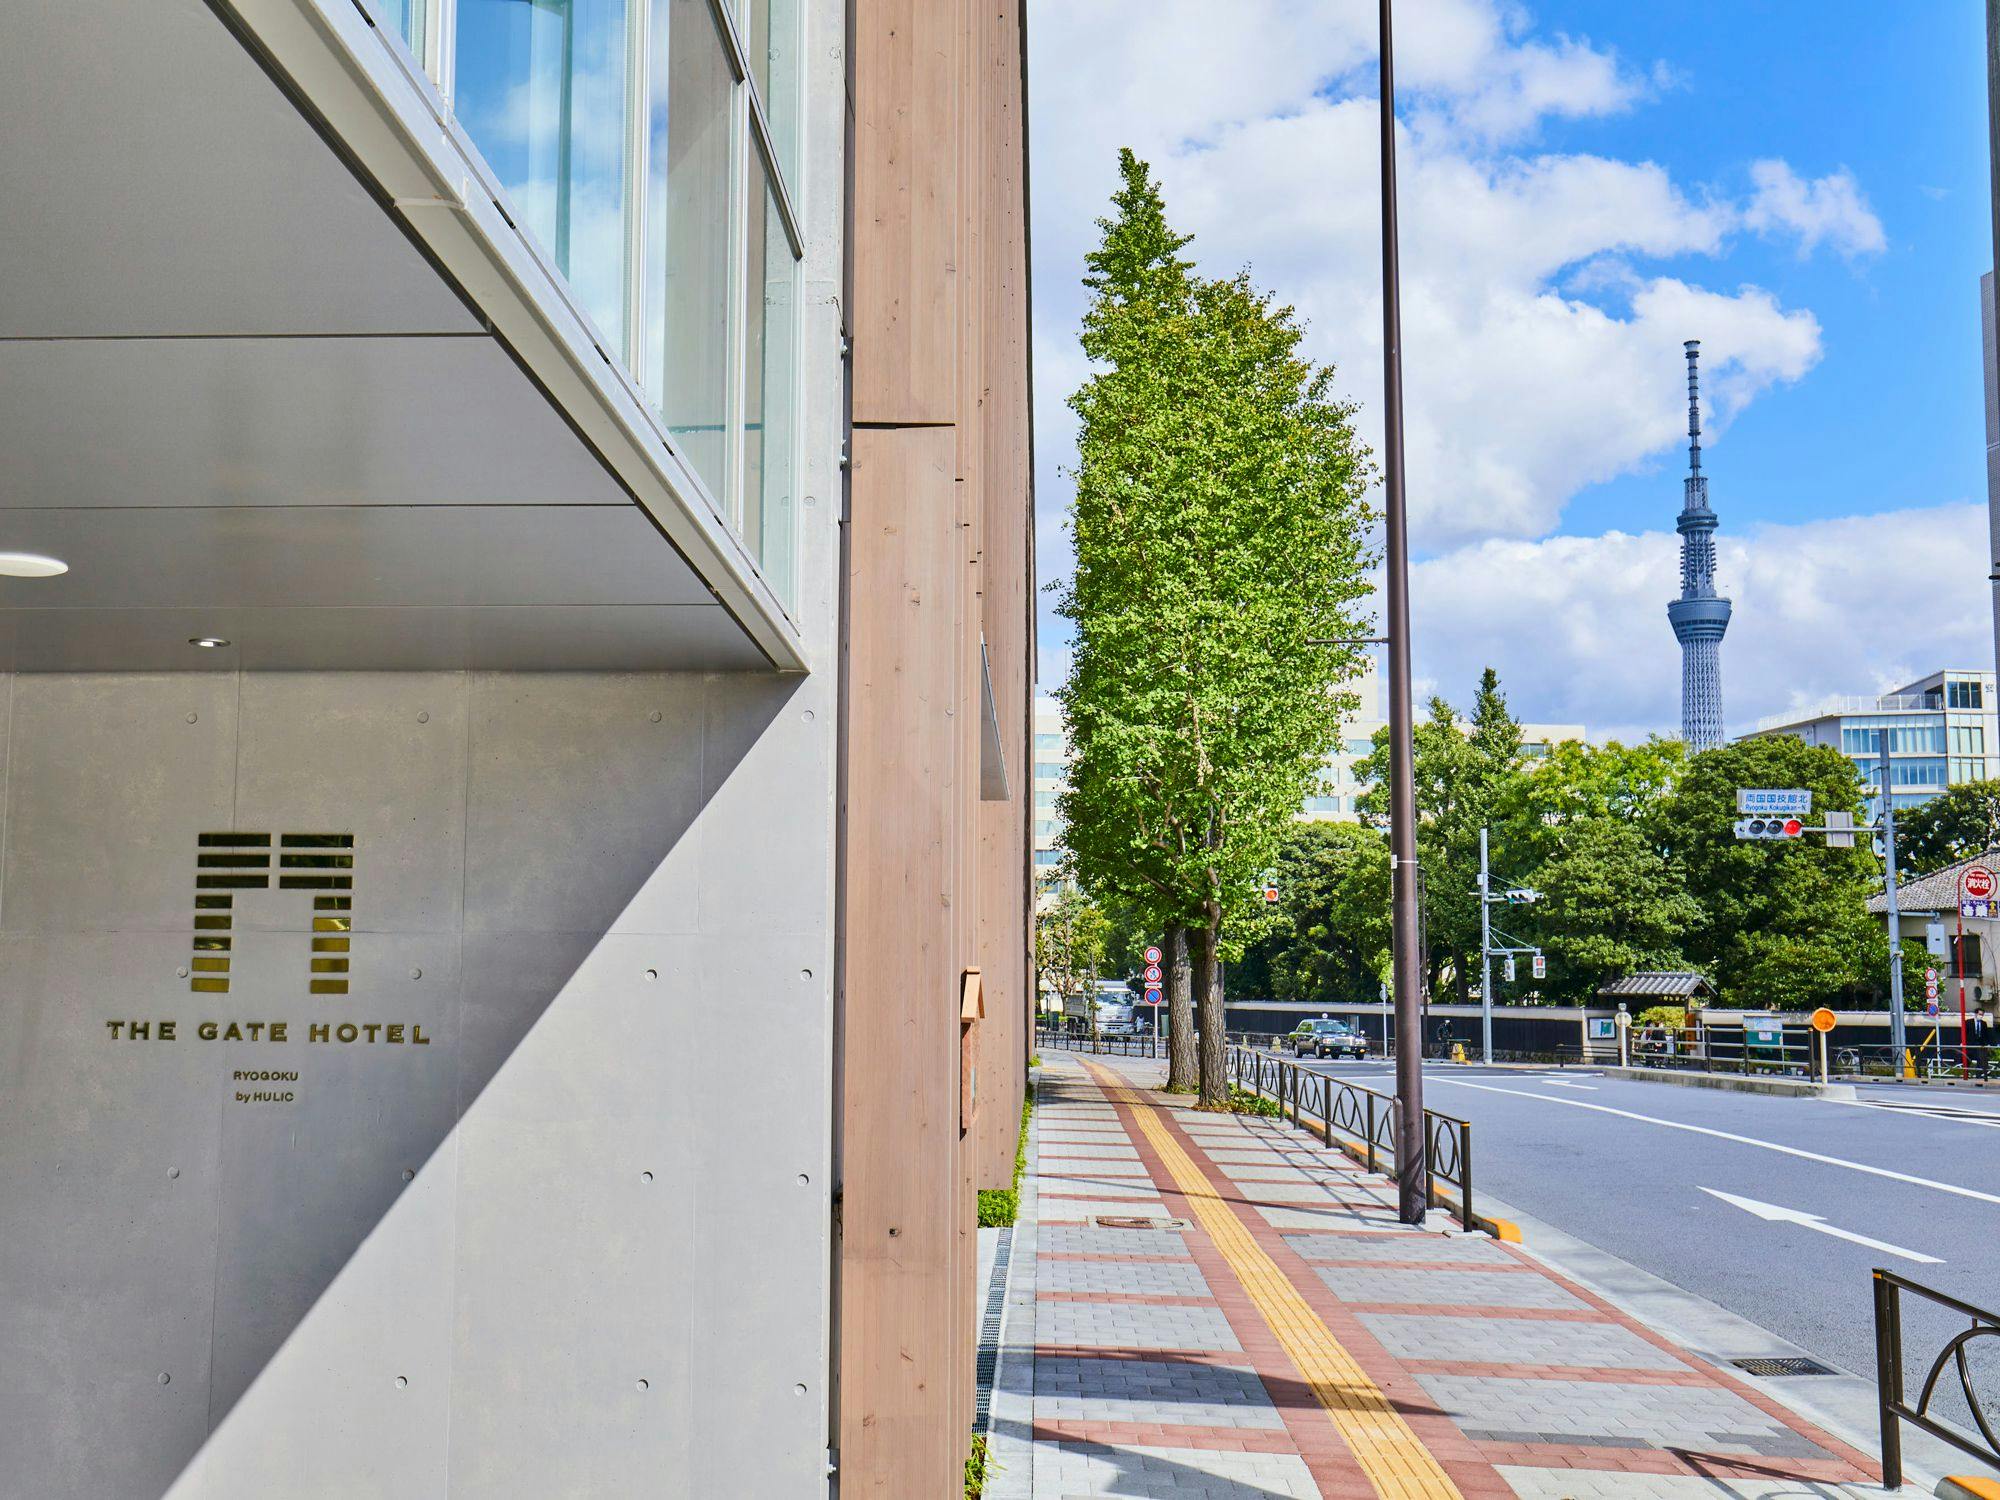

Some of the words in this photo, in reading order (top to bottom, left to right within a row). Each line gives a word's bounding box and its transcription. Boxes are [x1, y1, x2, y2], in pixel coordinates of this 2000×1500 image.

[1967, 878, 1989, 889] 消火栓
[107, 1021, 177, 1041] THE
[198, 1022, 288, 1043] GATE
[309, 1023, 431, 1045] HOTEL
[233, 1071, 299, 1081] RYOGOKU
[236, 1091, 251, 1103] by
[253, 1092, 294, 1102] HULIC
